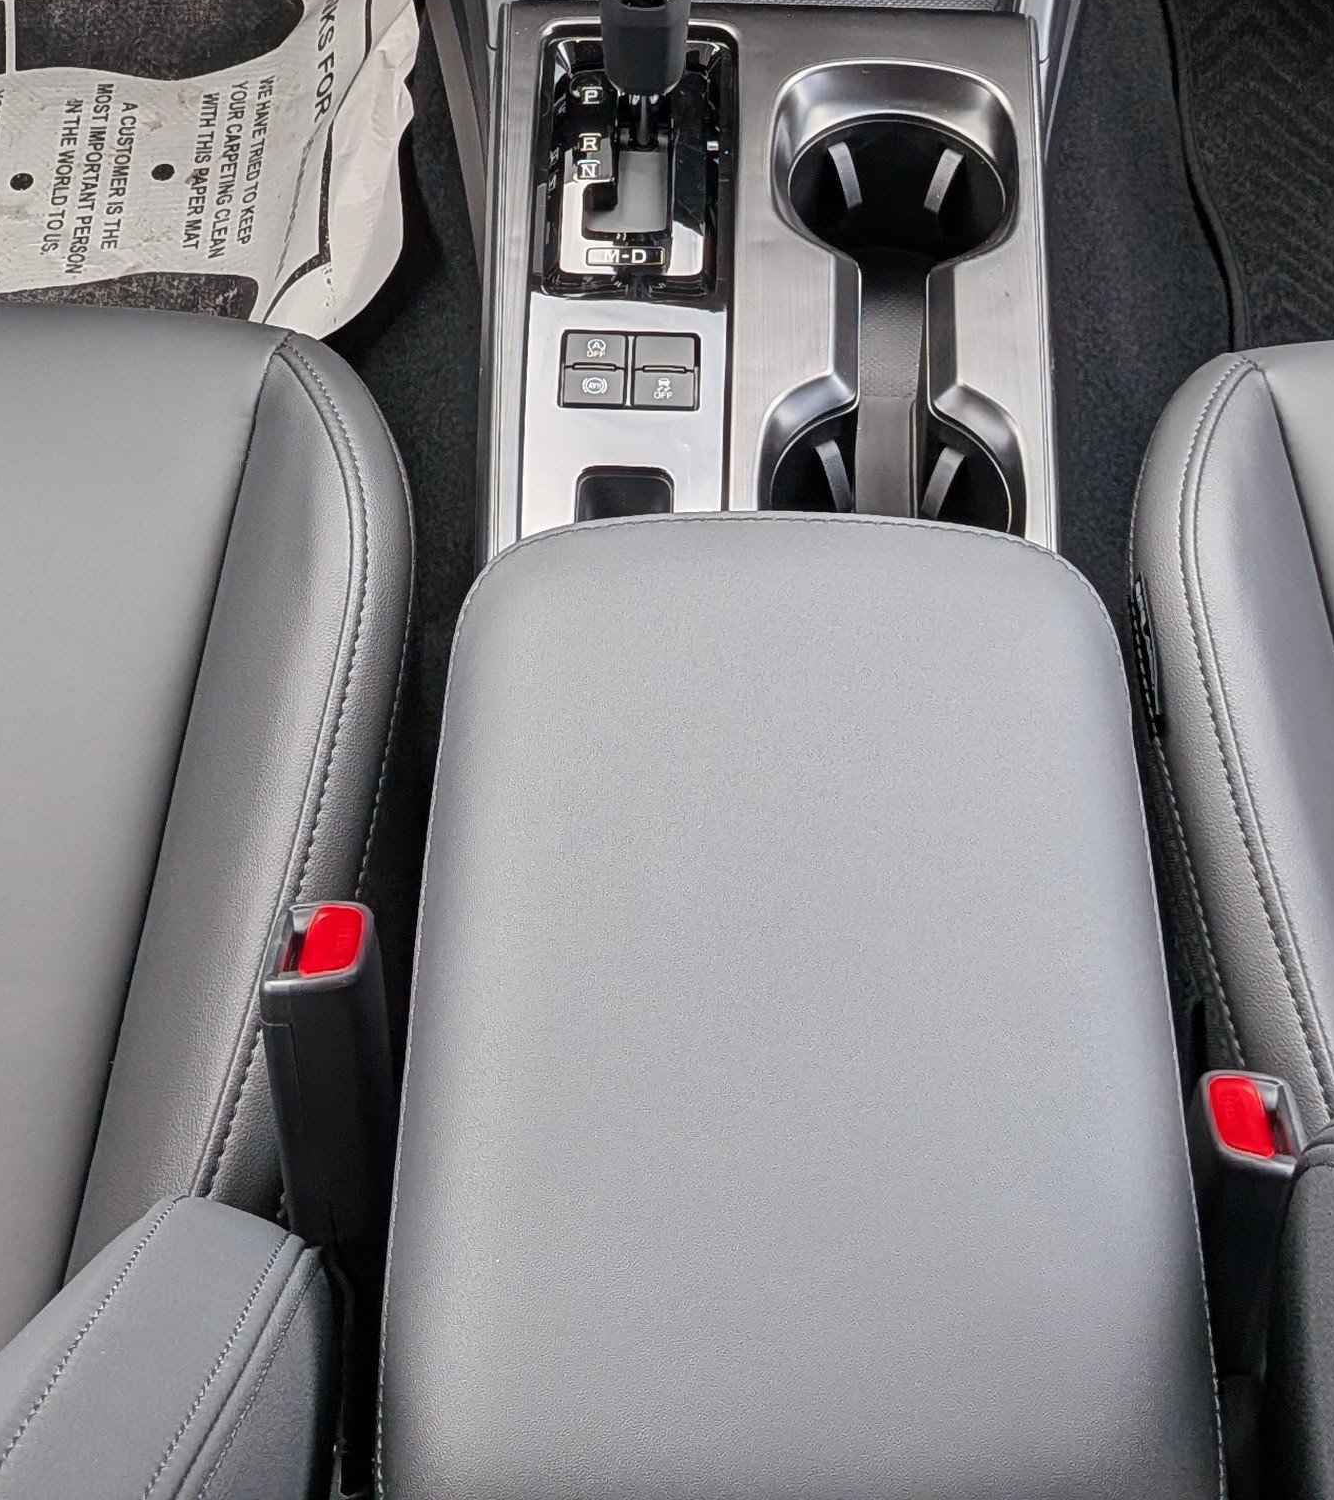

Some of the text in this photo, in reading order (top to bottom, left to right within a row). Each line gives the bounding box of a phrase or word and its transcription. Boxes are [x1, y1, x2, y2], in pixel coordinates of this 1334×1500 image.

[314, 51, 335, 124] FOR
[60, 114, 81, 148] THE
[236, 75, 275, 245] WE HAVE TRIED TO KEEP
[50, 149, 75, 207] WORLD
[64, 83, 114, 275] MOST IMPORTANT PERSON
[101, 101, 138, 250] A CUSTOMER IS THE
[182, 92, 220, 250] WITH THIS PAPER MAT
[207, 80, 249, 260] YOUR CARPETING CLEAN
[39, 233, 62, 256] US.
[46, 209, 65, 231] TO
[586, 350, 606, 358] OFF
[653, 391, 673, 399] OFF
